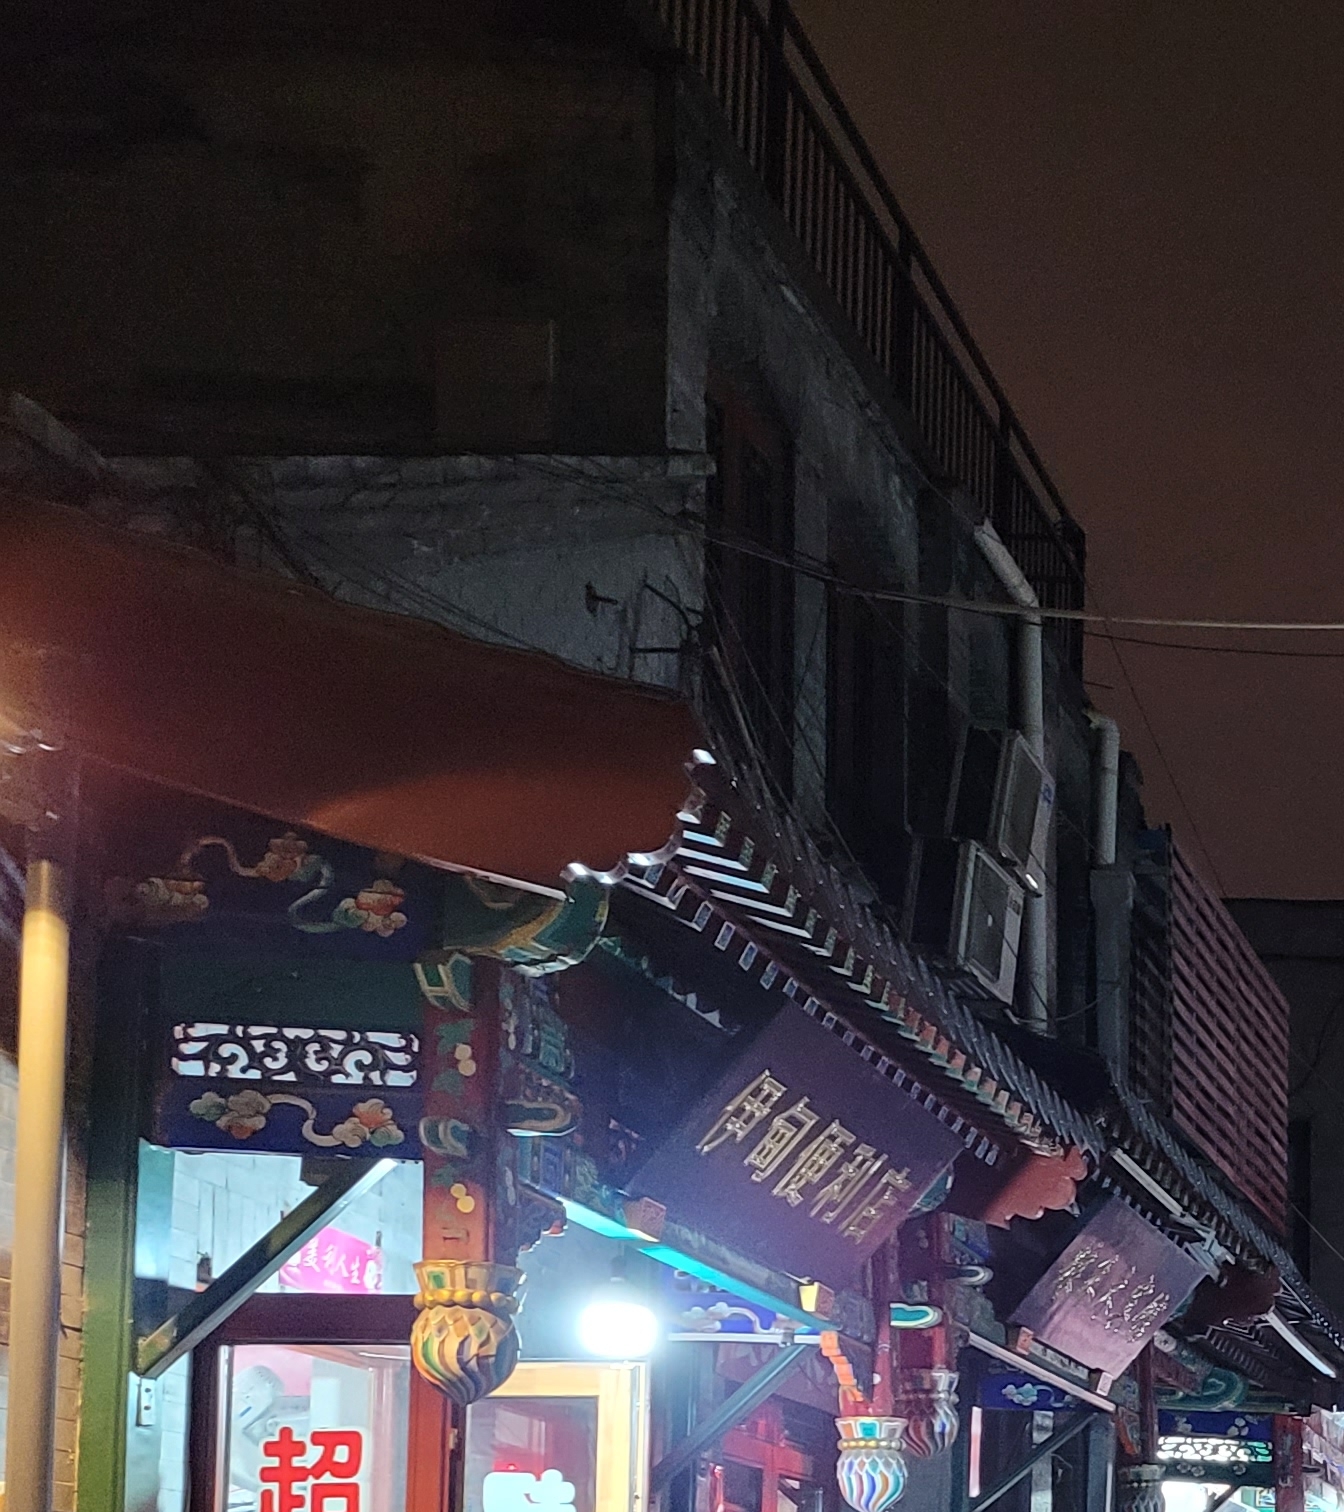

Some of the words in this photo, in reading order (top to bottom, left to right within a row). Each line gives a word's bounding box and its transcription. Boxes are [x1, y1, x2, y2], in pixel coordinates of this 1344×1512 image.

[697, 1069, 911, 1243] 伊甸便利店
